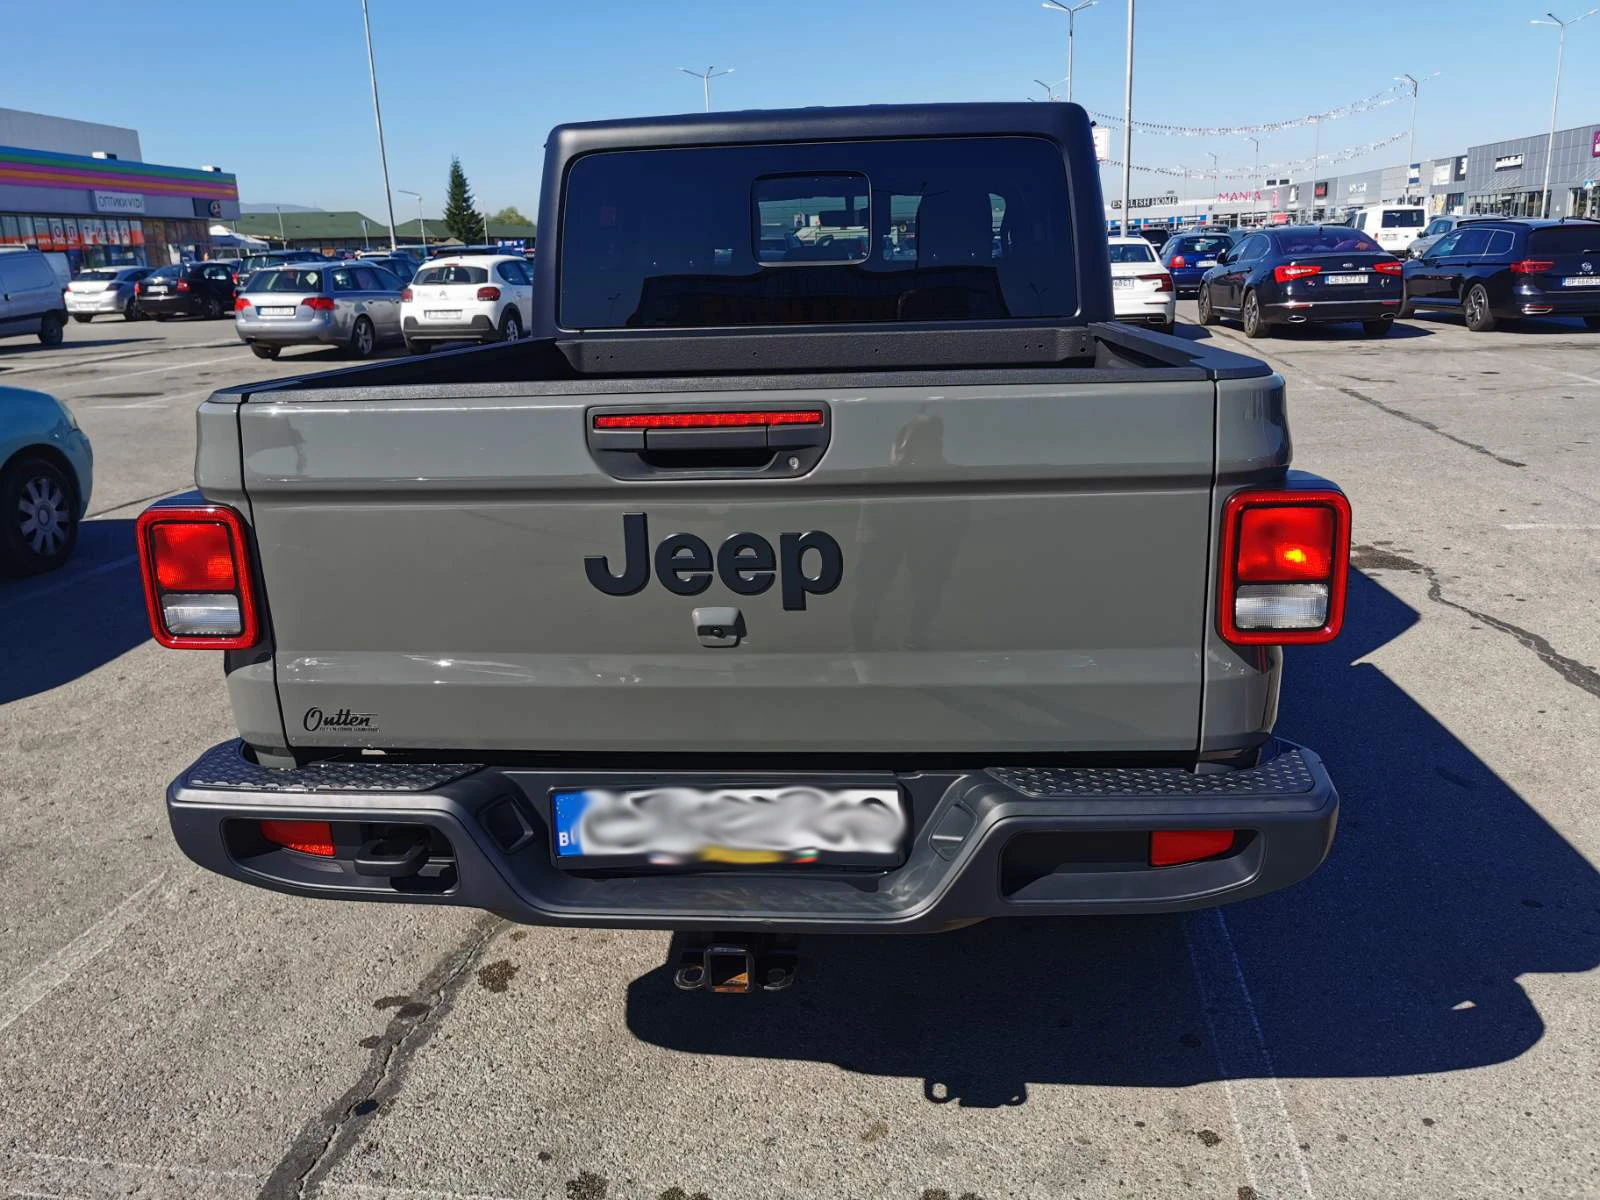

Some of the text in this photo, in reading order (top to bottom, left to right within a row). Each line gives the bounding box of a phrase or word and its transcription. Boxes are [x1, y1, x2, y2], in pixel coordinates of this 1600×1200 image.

[1111, 199, 1151, 209] ENLISH
[584, 512, 843, 611] Jeep
[303, 706, 377, 731] Outten
